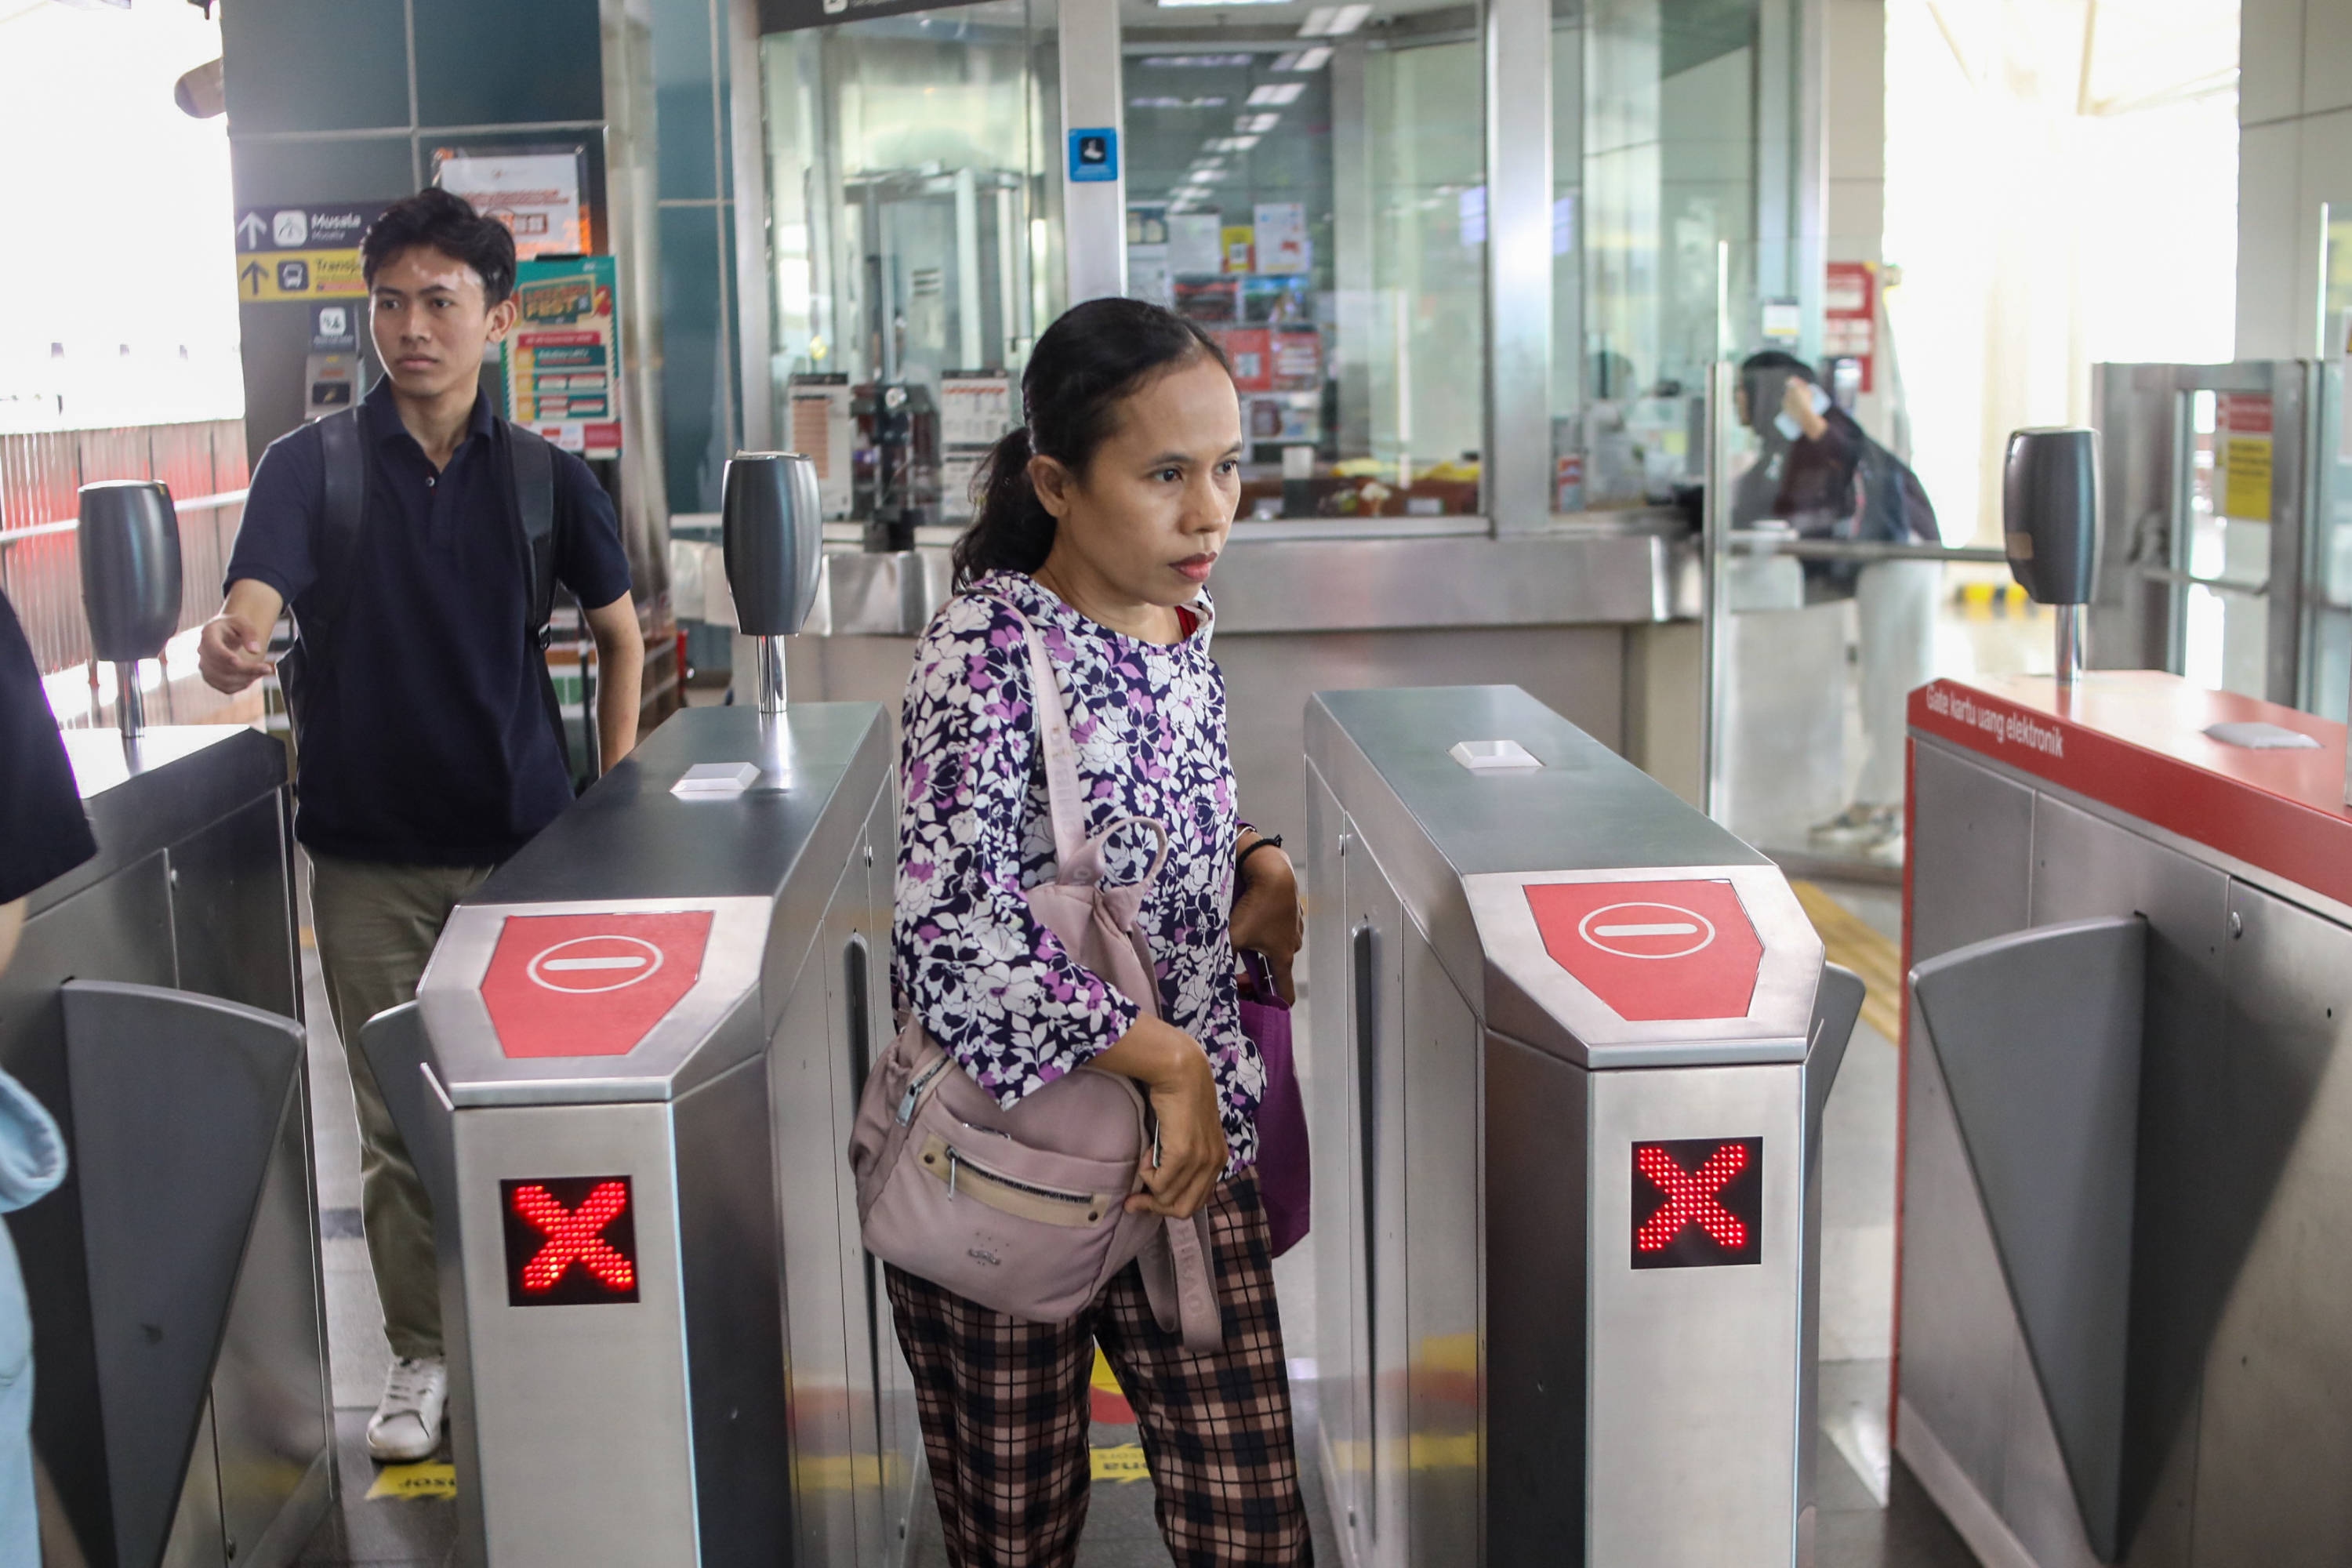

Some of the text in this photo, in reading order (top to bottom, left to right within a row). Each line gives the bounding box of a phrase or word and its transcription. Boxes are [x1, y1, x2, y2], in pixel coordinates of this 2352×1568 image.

[1926, 684, 2063, 759] Gate kartu uang elektronik
